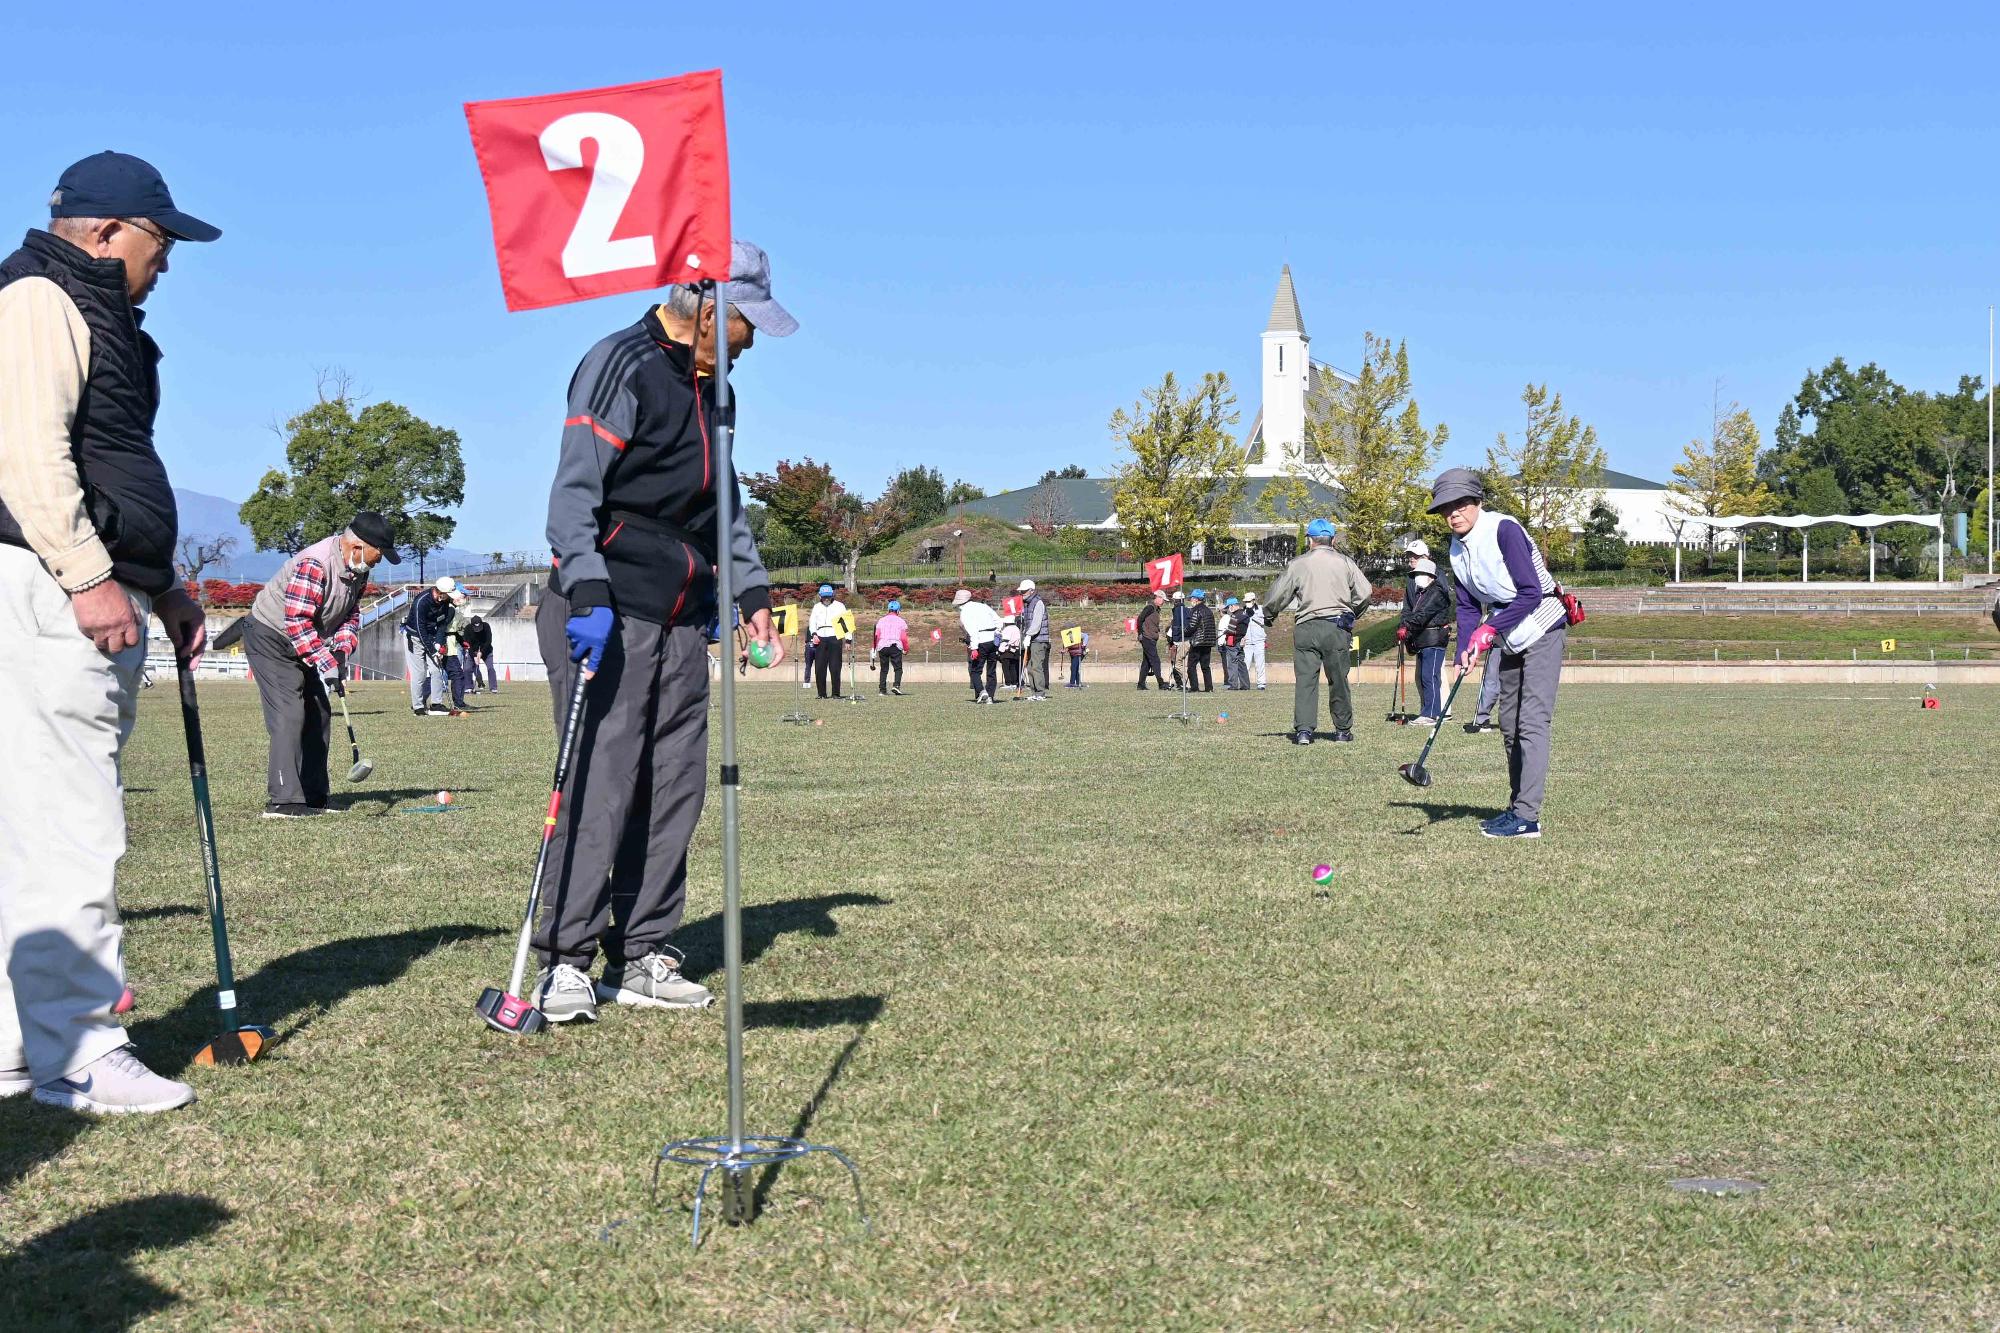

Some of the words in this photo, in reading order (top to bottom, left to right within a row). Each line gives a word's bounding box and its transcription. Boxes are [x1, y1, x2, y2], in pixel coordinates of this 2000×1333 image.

[538, 111, 657, 279] 2
[1155, 560, 1172, 586] 7
[1008, 599, 1017, 614] 1
[837, 617, 849, 633] 1
[1066, 630, 1074, 643] 1
[1884, 641, 1891, 650] 2
[1927, 700, 1936, 709] 2
